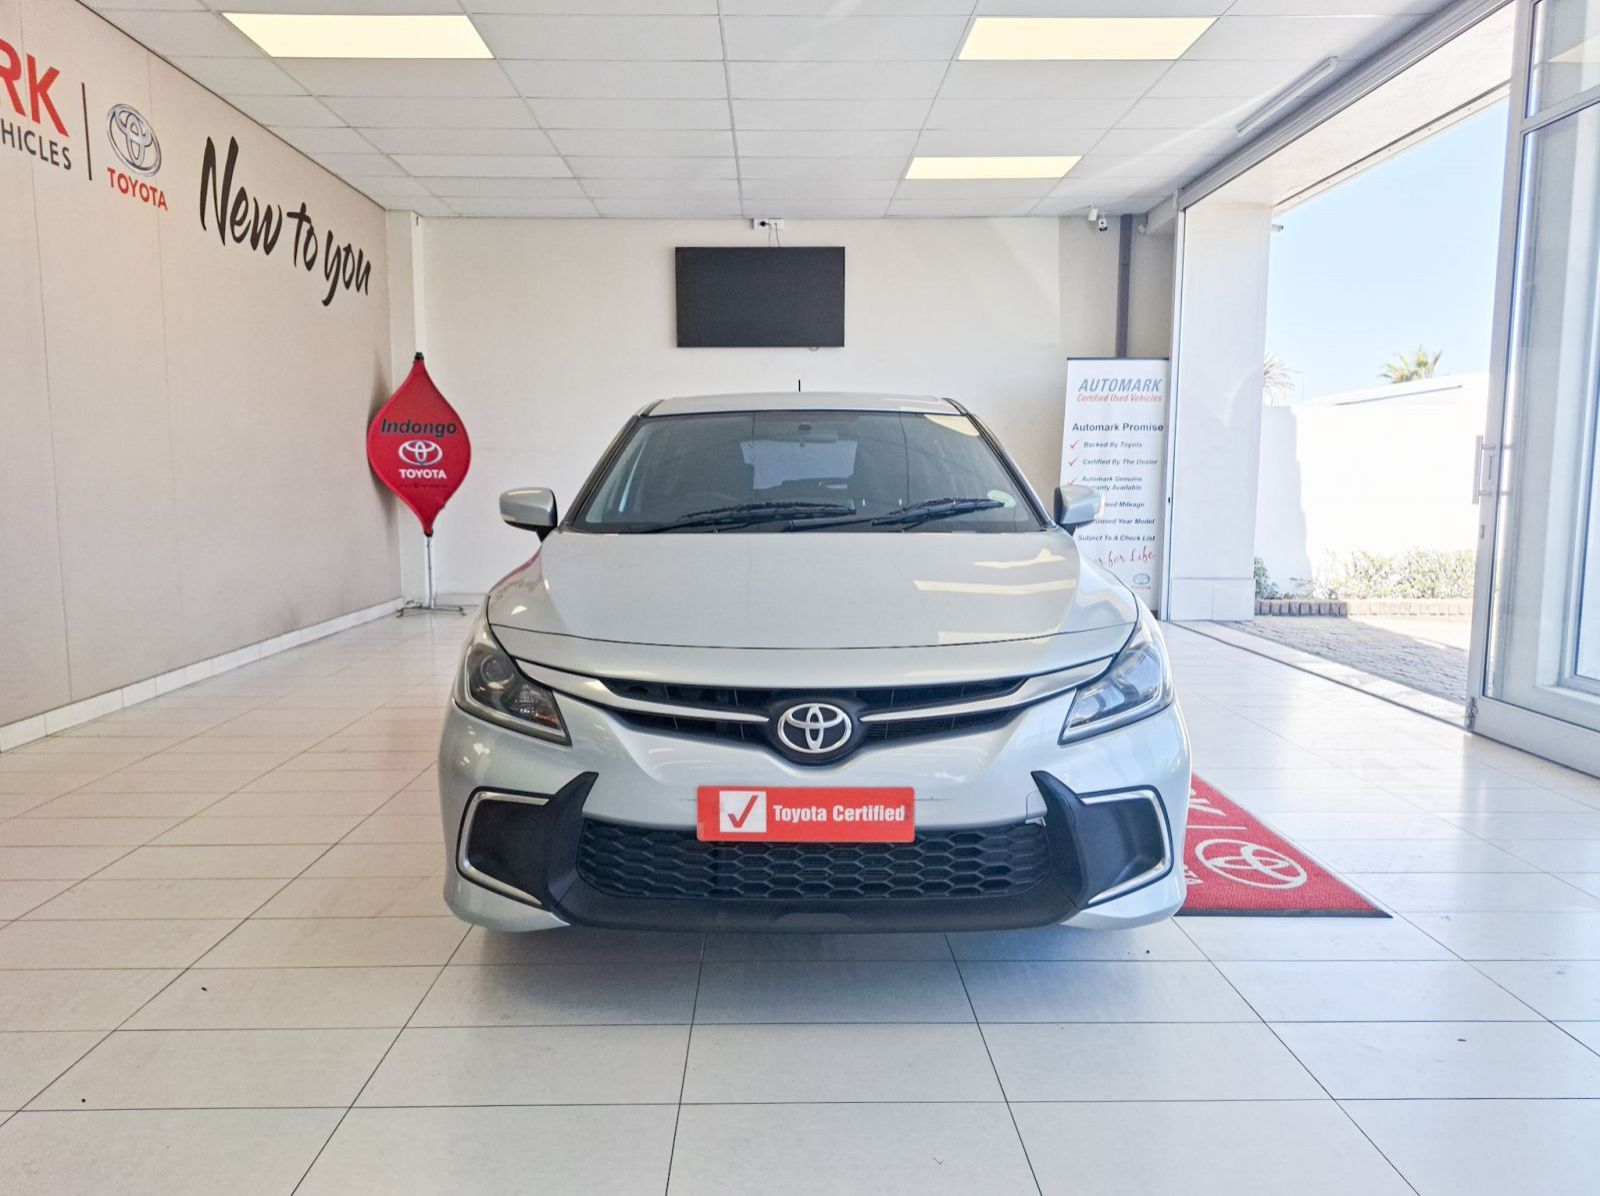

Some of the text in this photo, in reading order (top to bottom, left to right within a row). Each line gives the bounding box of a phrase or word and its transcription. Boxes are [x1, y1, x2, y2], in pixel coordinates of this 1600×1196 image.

[107, 167, 168, 212] TOYOTA
[200, 136, 373, 306] New to you
[1078, 378, 1162, 393] AUTOMARK
[1077, 393, 1162, 402] Certified Used Vehicles
[381, 418, 457, 438] Indongo
[1072, 422, 1164, 432] Automark Promise
[1109, 441, 1118, 449] By
[1120, 441, 1143, 449] Toyota
[1112, 458, 1120, 466] By
[399, 468, 447, 479] TOYOTA
[1077, 535, 1103, 543] Subject
[1109, 550, 1125, 568] for
[1130, 544, 1156, 564] Life
[773, 804, 905, 824] Toyota Certified
